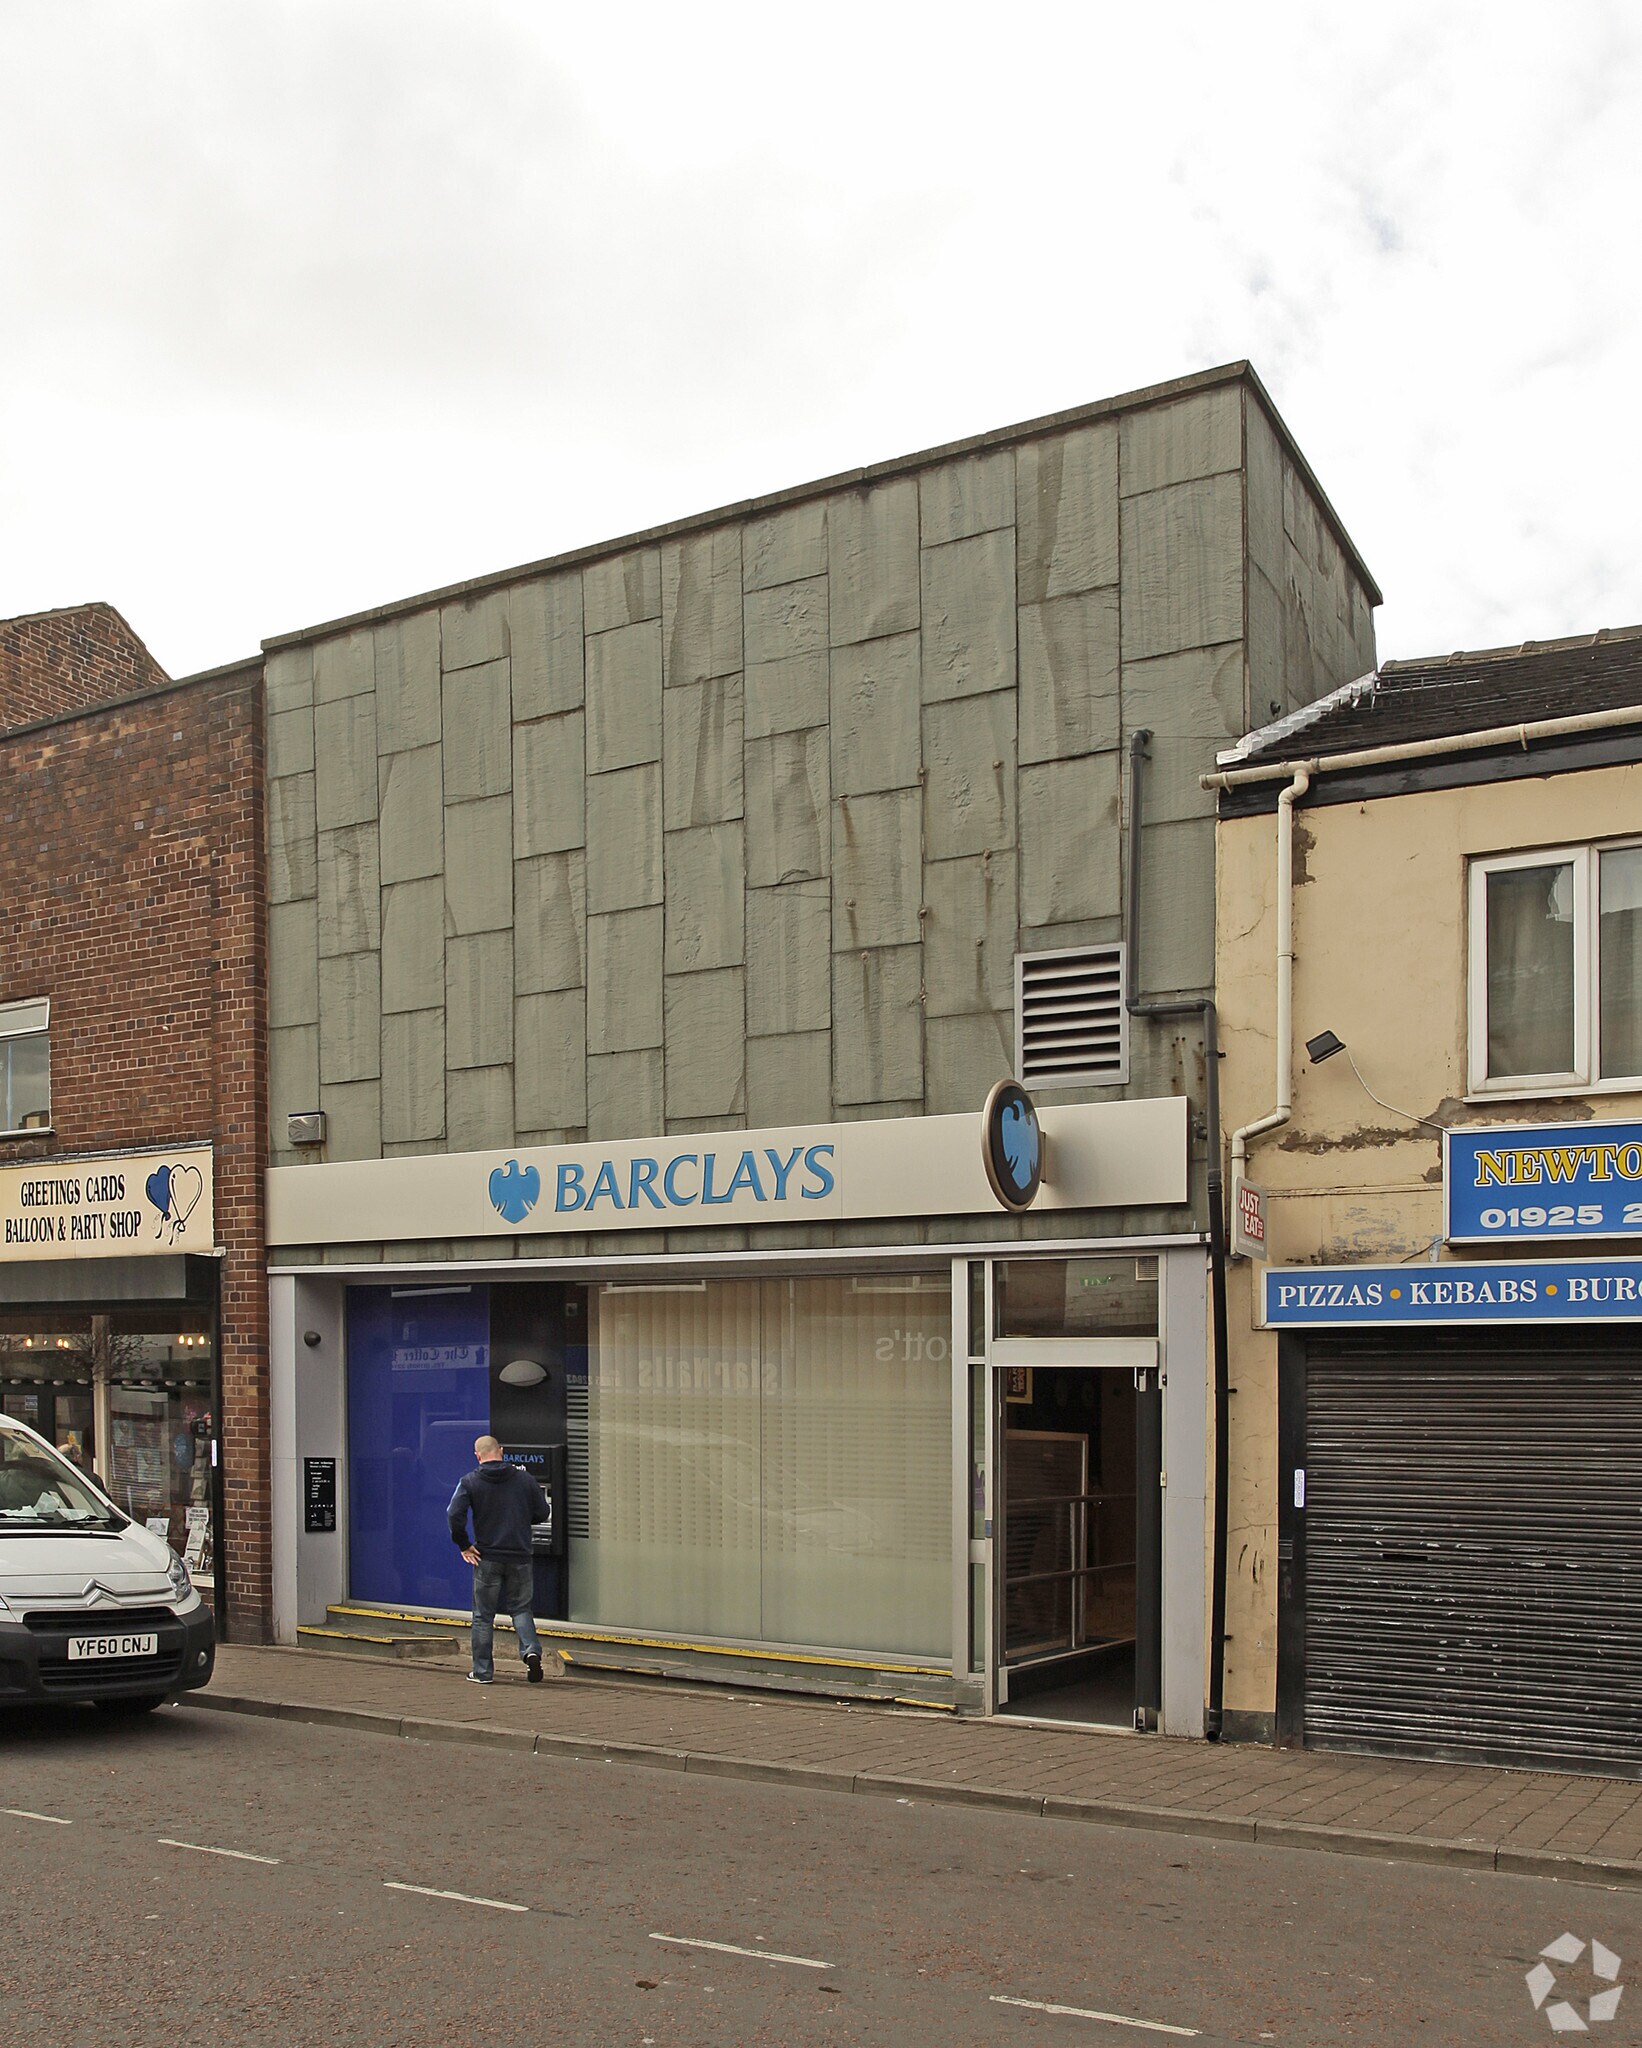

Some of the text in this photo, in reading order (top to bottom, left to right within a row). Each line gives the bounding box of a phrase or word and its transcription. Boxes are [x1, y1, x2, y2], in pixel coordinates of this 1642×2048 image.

[1474, 1142, 1642, 1186] NEWTO
[20, 1174, 125, 1207] GREETINGS CARDS
[554, 1144, 835, 1213] BARCLAYS
[1240, 1189, 1259, 1215] JUST
[5, 1211, 141, 1243] BALLOON & PARTY SHOP
[1244, 1212, 1259, 1236] EAT
[1480, 1205, 1604, 1229] 01925
[1278, 1277, 1642, 1307] PIZZAS KEBABS BUR
[503, 1454, 545, 1464] BARCLAYS
[76, 1636, 151, 1656] YF60 CNJ
